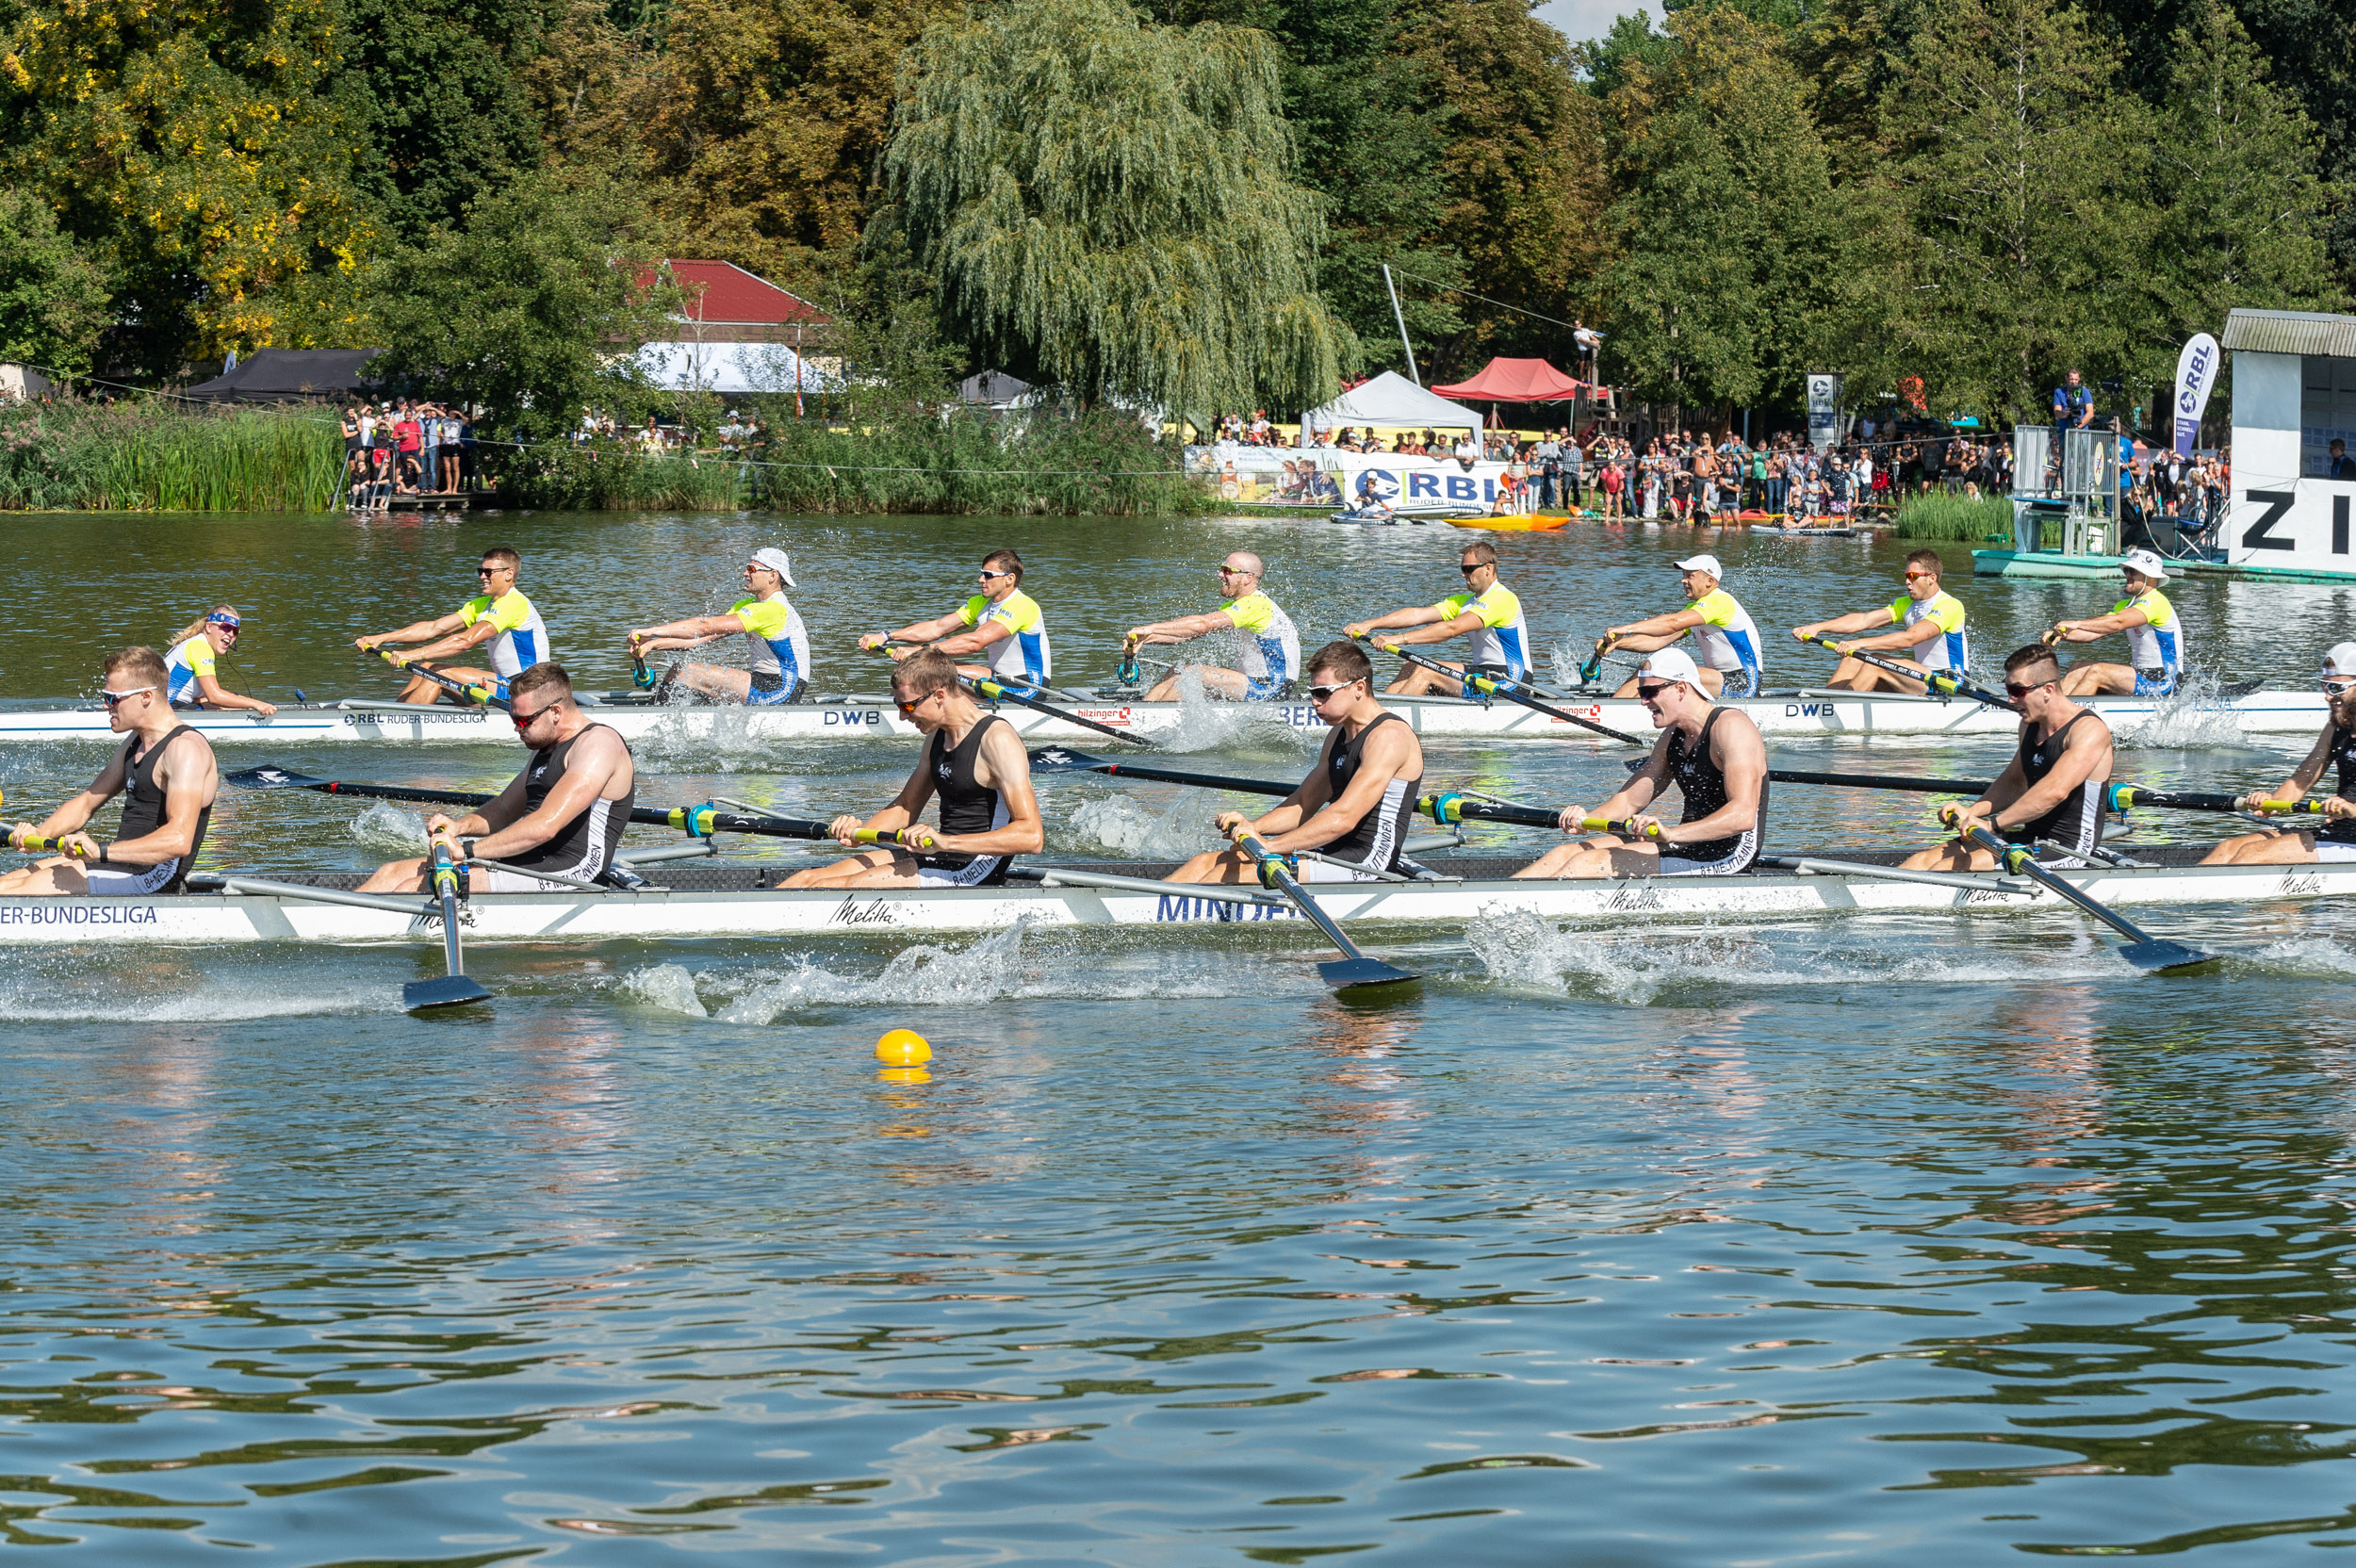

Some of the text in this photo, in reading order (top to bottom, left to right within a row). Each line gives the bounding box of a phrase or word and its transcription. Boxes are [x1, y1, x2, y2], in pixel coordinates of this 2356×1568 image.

[2184, 345, 2210, 391] RBL
[1409, 472, 1512, 502] RBL
[824, 710, 880, 726] DWB
[1077, 709, 1118, 720] hilzinger
[1550, 705, 1589, 717] ilzinger
[1785, 703, 1835, 717] DWB
[358, 713, 487, 725] RBL RUDER-BUNDESLIGA
[2273, 867, 2322, 895] Melitta
[1, 906, 157, 923] ER-BUNDESLIGA
[826, 893, 894, 925] Melitta
